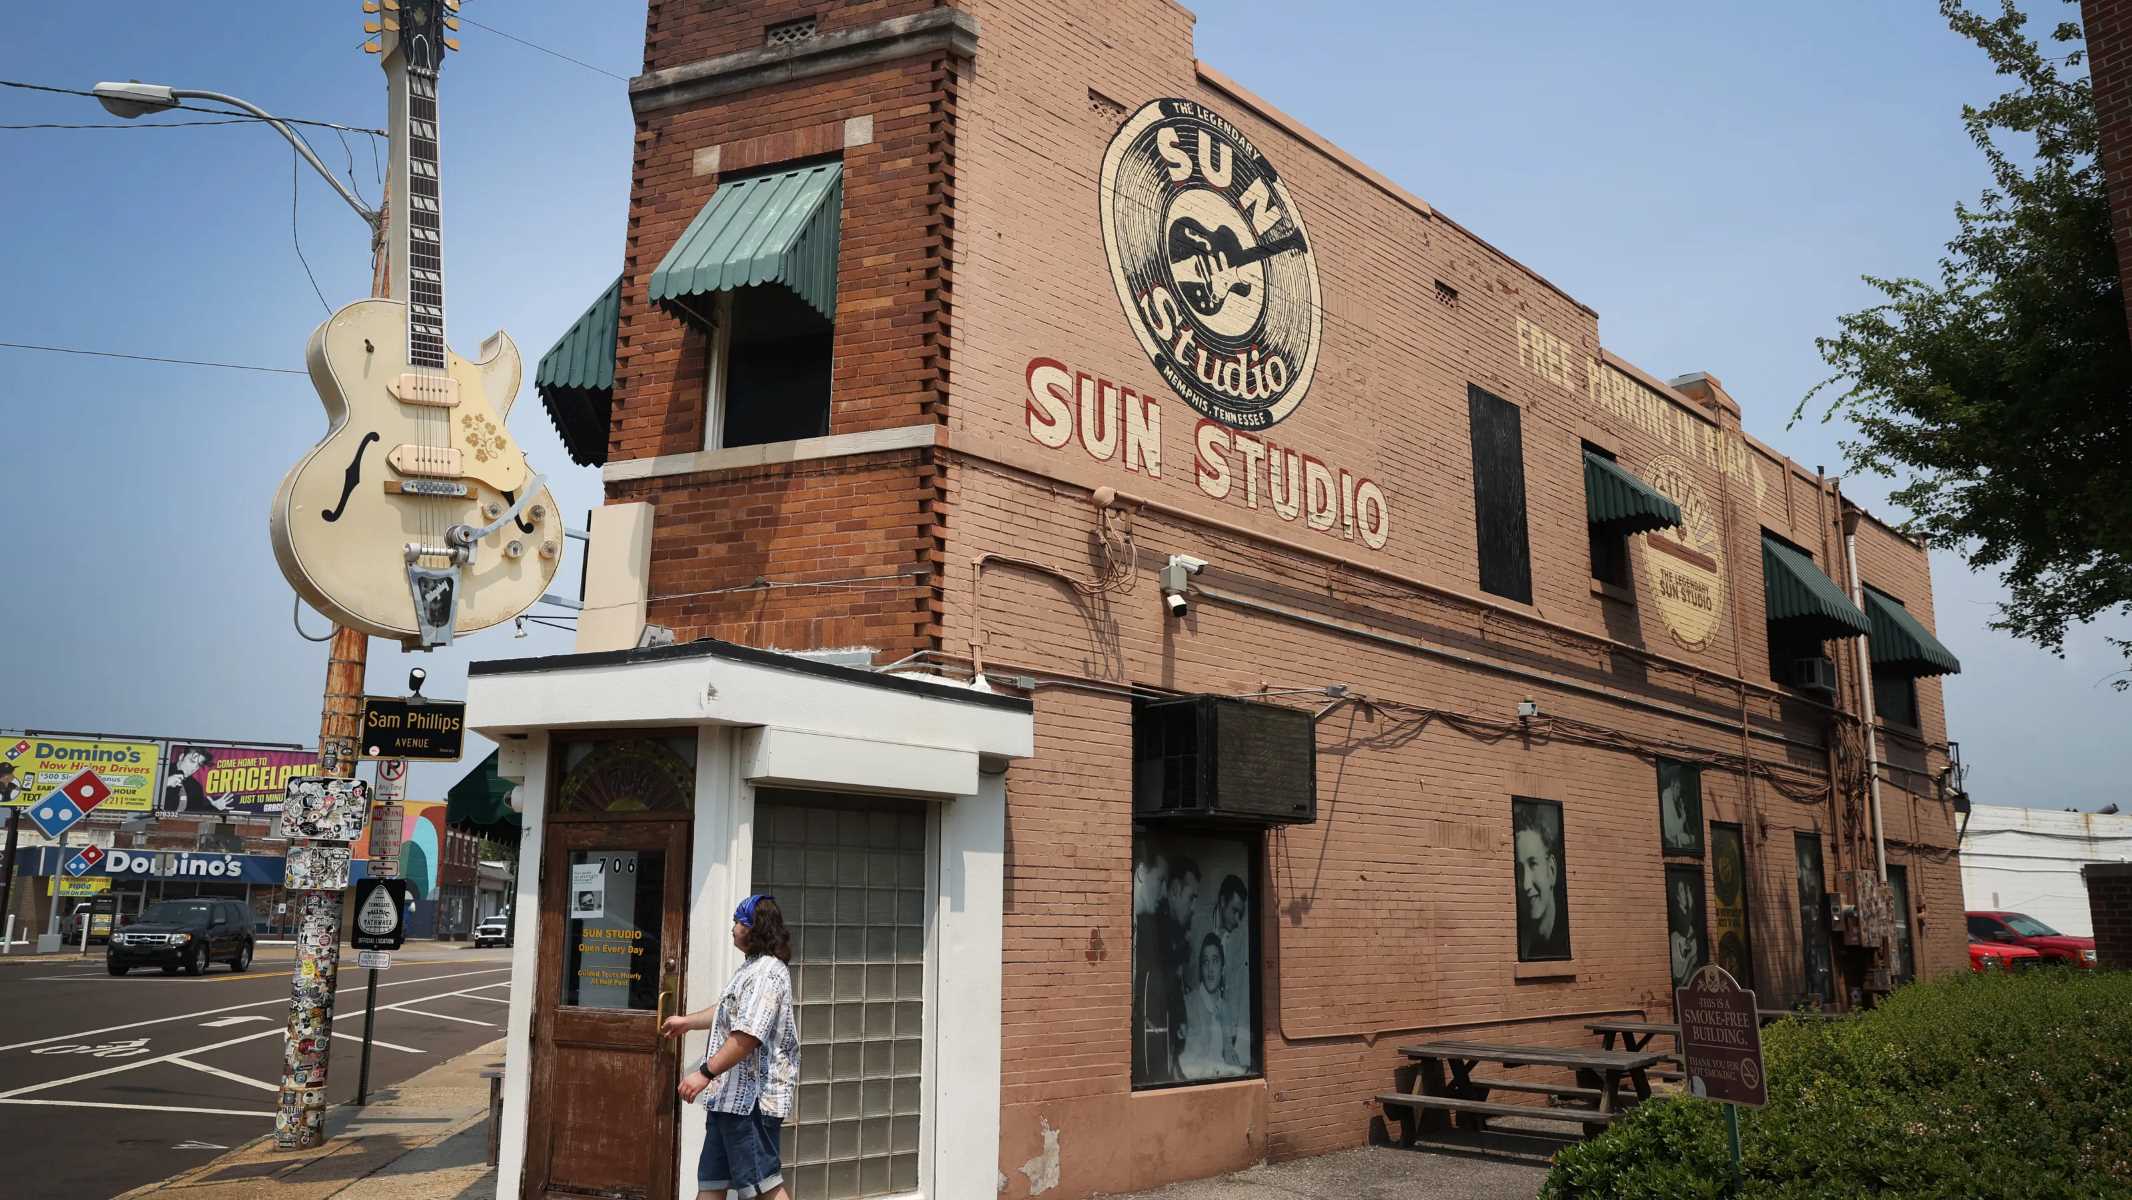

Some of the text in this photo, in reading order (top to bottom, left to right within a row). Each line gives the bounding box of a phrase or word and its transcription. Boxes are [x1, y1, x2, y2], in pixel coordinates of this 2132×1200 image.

[1173, 102, 1261, 160] THE LEGENDARY
[1157, 127, 1283, 237] SUN
[1140, 283, 1287, 400] Studio
[1515, 316, 1575, 393] FREE
[1586, 356, 1673, 446] PARKING
[1213, 406, 1267, 426] TENNESSEE
[1026, 357, 1390, 550] SUN STUDIO
[1660, 568, 1672, 582] THE
[1660, 580, 1712, 612] SUN STUDIO
[368, 711, 460, 734] Sam Phillips
[395, 738, 430, 749] AVENUE
[35, 742, 141, 763] Domino's
[39, 761, 67, 771] Now
[110, 764, 151, 775] Drivers
[217, 757, 268, 769] COME HOME TO
[23, 792, 42, 802] TEXT
[113, 788, 137, 796] HOUR
[240, 794, 256, 804] JUST
[599, 858, 635, 874] 706
[583, 929, 642, 940] SUN STUDIO
[578, 943, 644, 956] Open Every Day
[1699, 999, 1730, 1010] THIS IS A
[1685, 1008, 1749, 1028] SMOKE-FREE
[1692, 1027, 1749, 1045] BUILDING.
